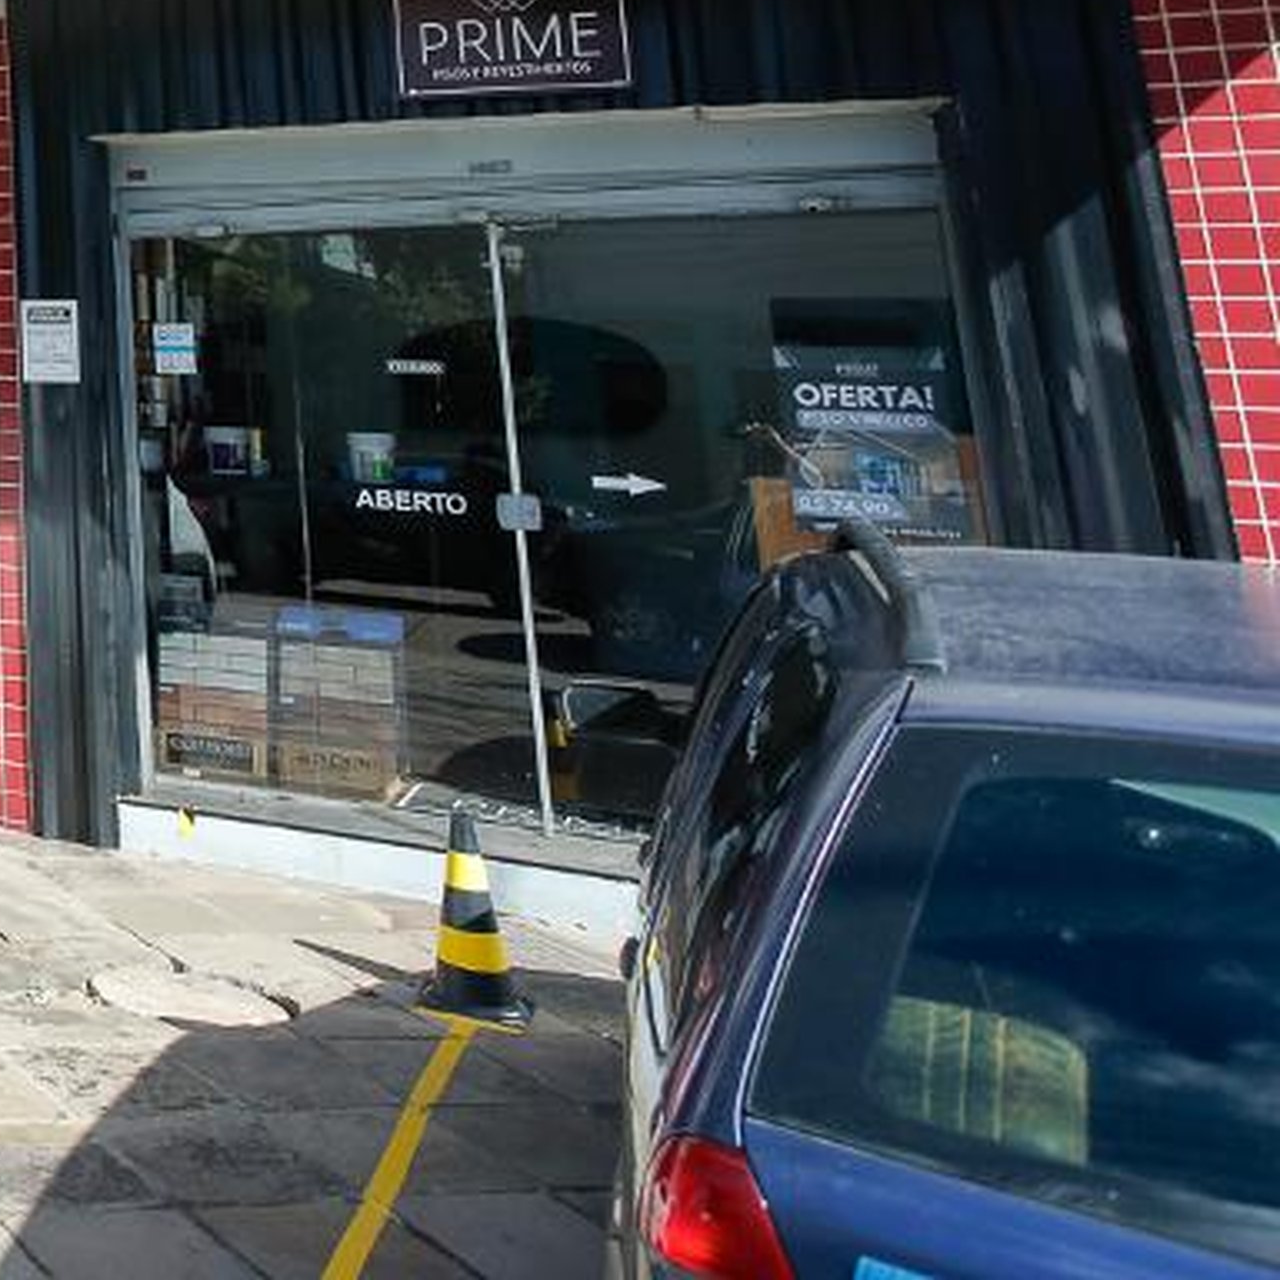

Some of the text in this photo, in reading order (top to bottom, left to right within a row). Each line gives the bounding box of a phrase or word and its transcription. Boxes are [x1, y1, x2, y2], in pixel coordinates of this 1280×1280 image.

[419, 11, 601, 66] PRIME
[793, 382, 935, 411] OFERTA!
[355, 487, 468, 516] ABERTO
